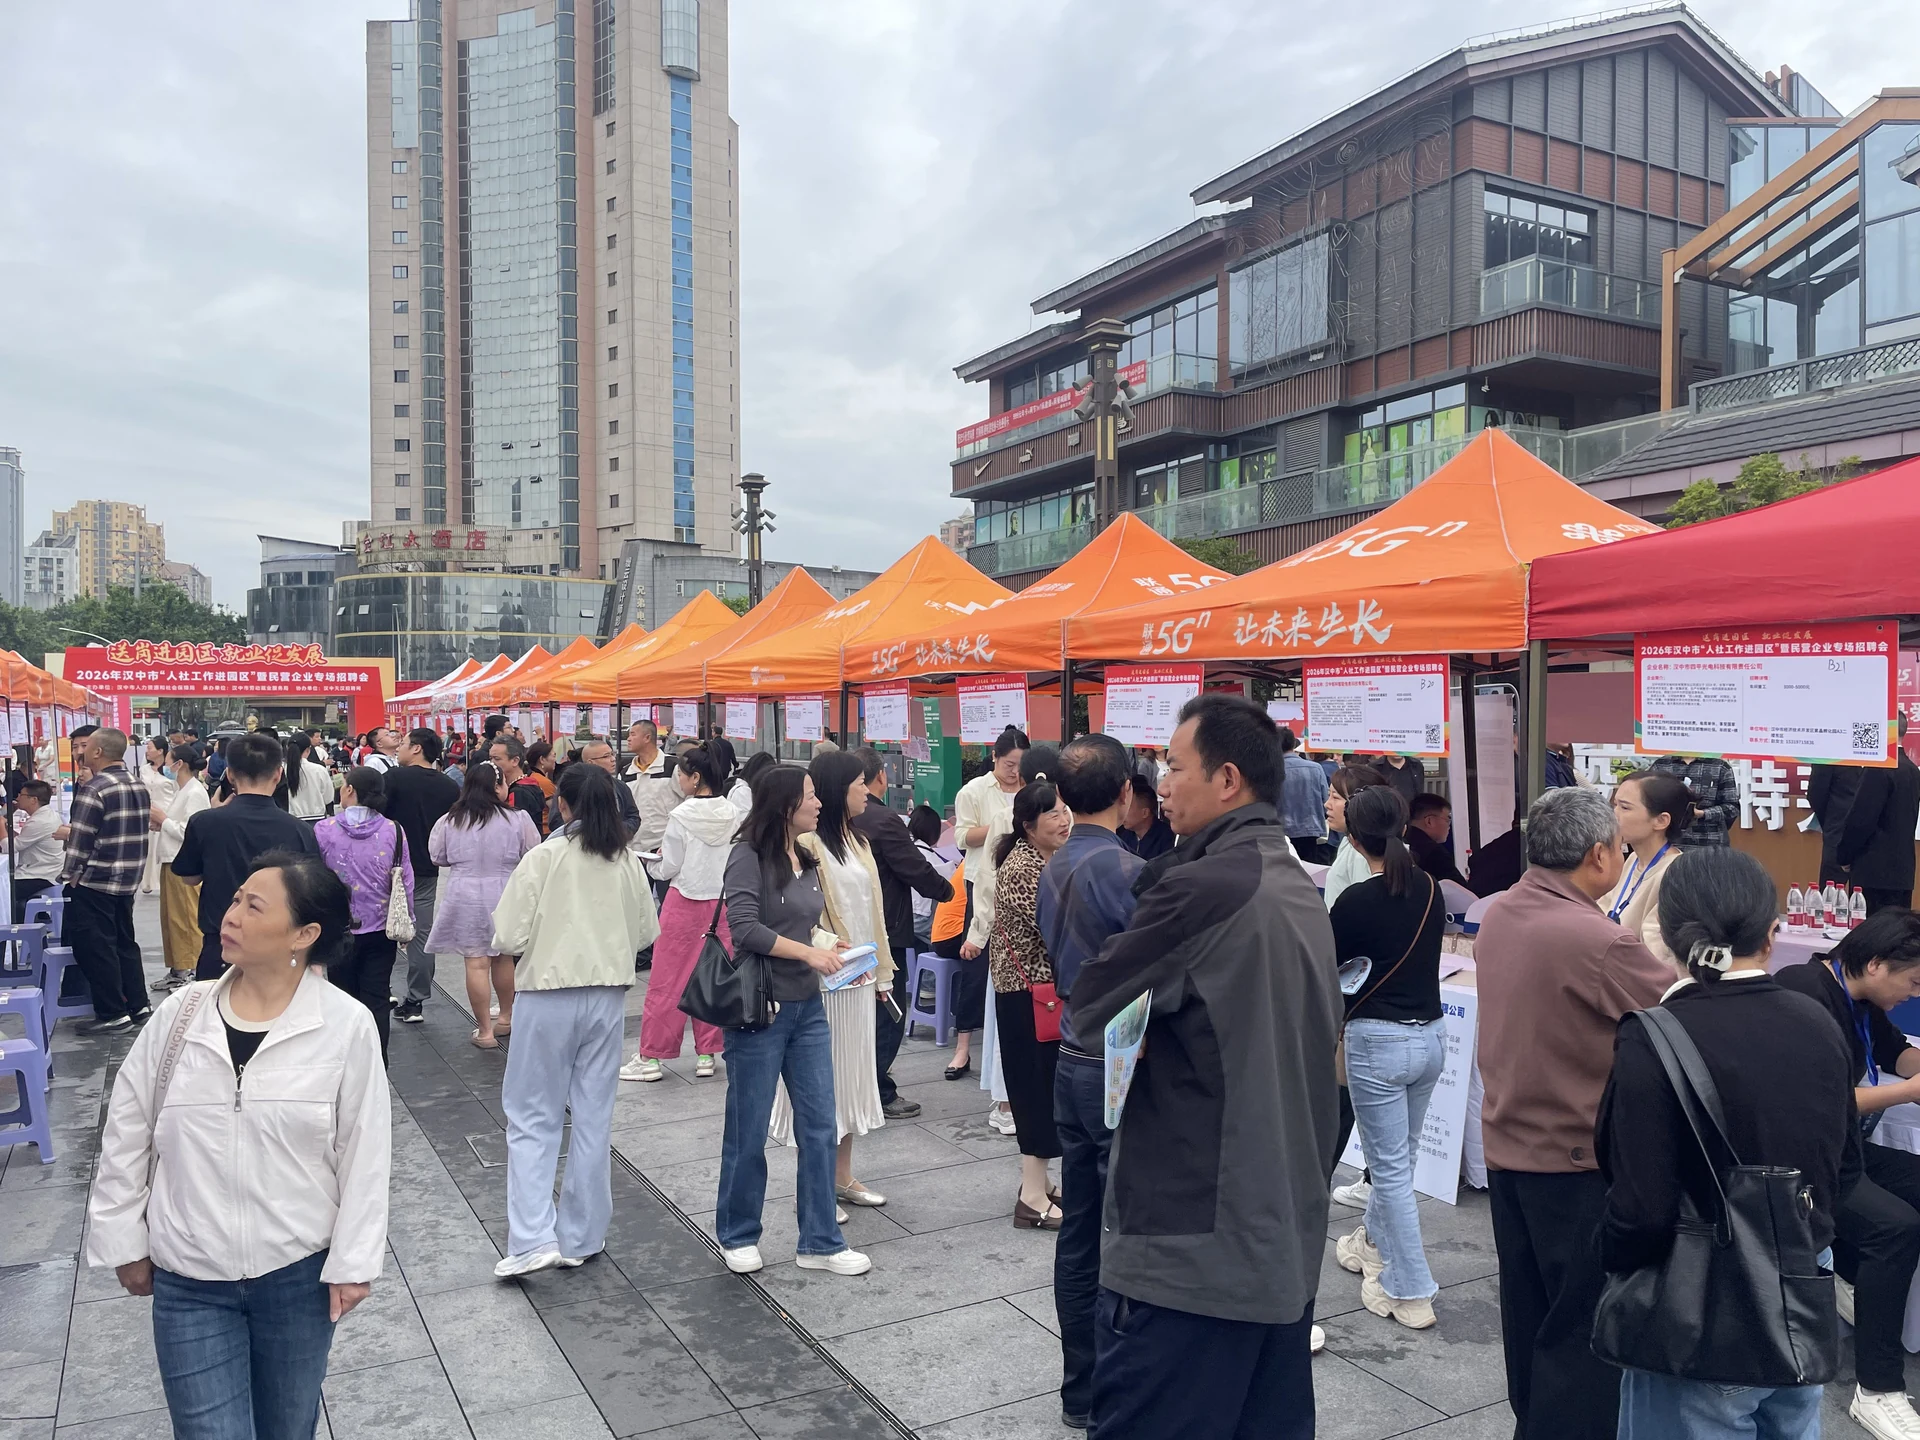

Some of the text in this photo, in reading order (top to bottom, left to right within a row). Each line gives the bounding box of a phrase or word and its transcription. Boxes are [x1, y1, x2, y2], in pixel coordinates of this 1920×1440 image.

[1233, 598, 1394, 648] 让未来生长
[1702, 630, 1813, 642] 送岗进园区 就业促发展
[108, 641, 327, 665] 送岗进园区 就业促发展
[1641, 641, 1888, 655] 2026年汉中市“人社工作进园区”暨民营企业专场招聘会
[1828, 659, 1846, 674] B21
[76, 670, 369, 682] 2026年汉中市“人社工作进园区”暨民营企业专场招聘会
